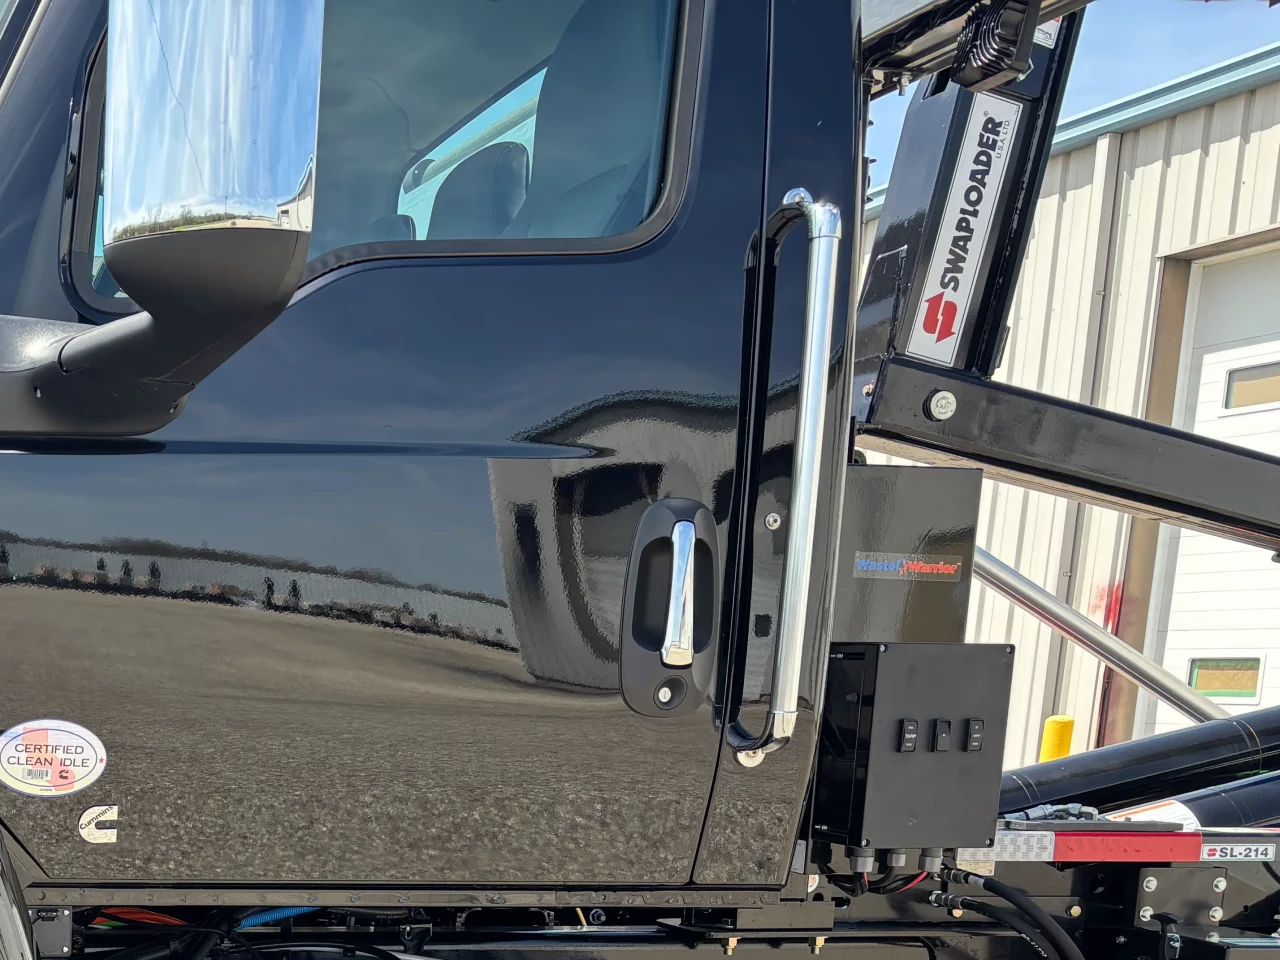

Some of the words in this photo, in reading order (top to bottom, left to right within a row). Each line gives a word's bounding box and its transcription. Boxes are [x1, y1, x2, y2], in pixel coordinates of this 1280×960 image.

[909, 560, 958, 574] Warrior
[14, 743, 84, 755] CERTIFIED
[7, 755, 54, 767] CLEAN
[59, 757, 90, 768] IDLE
[79, 805, 114, 830] Cummins
[1218, 846, 1269, 858] SL-214
